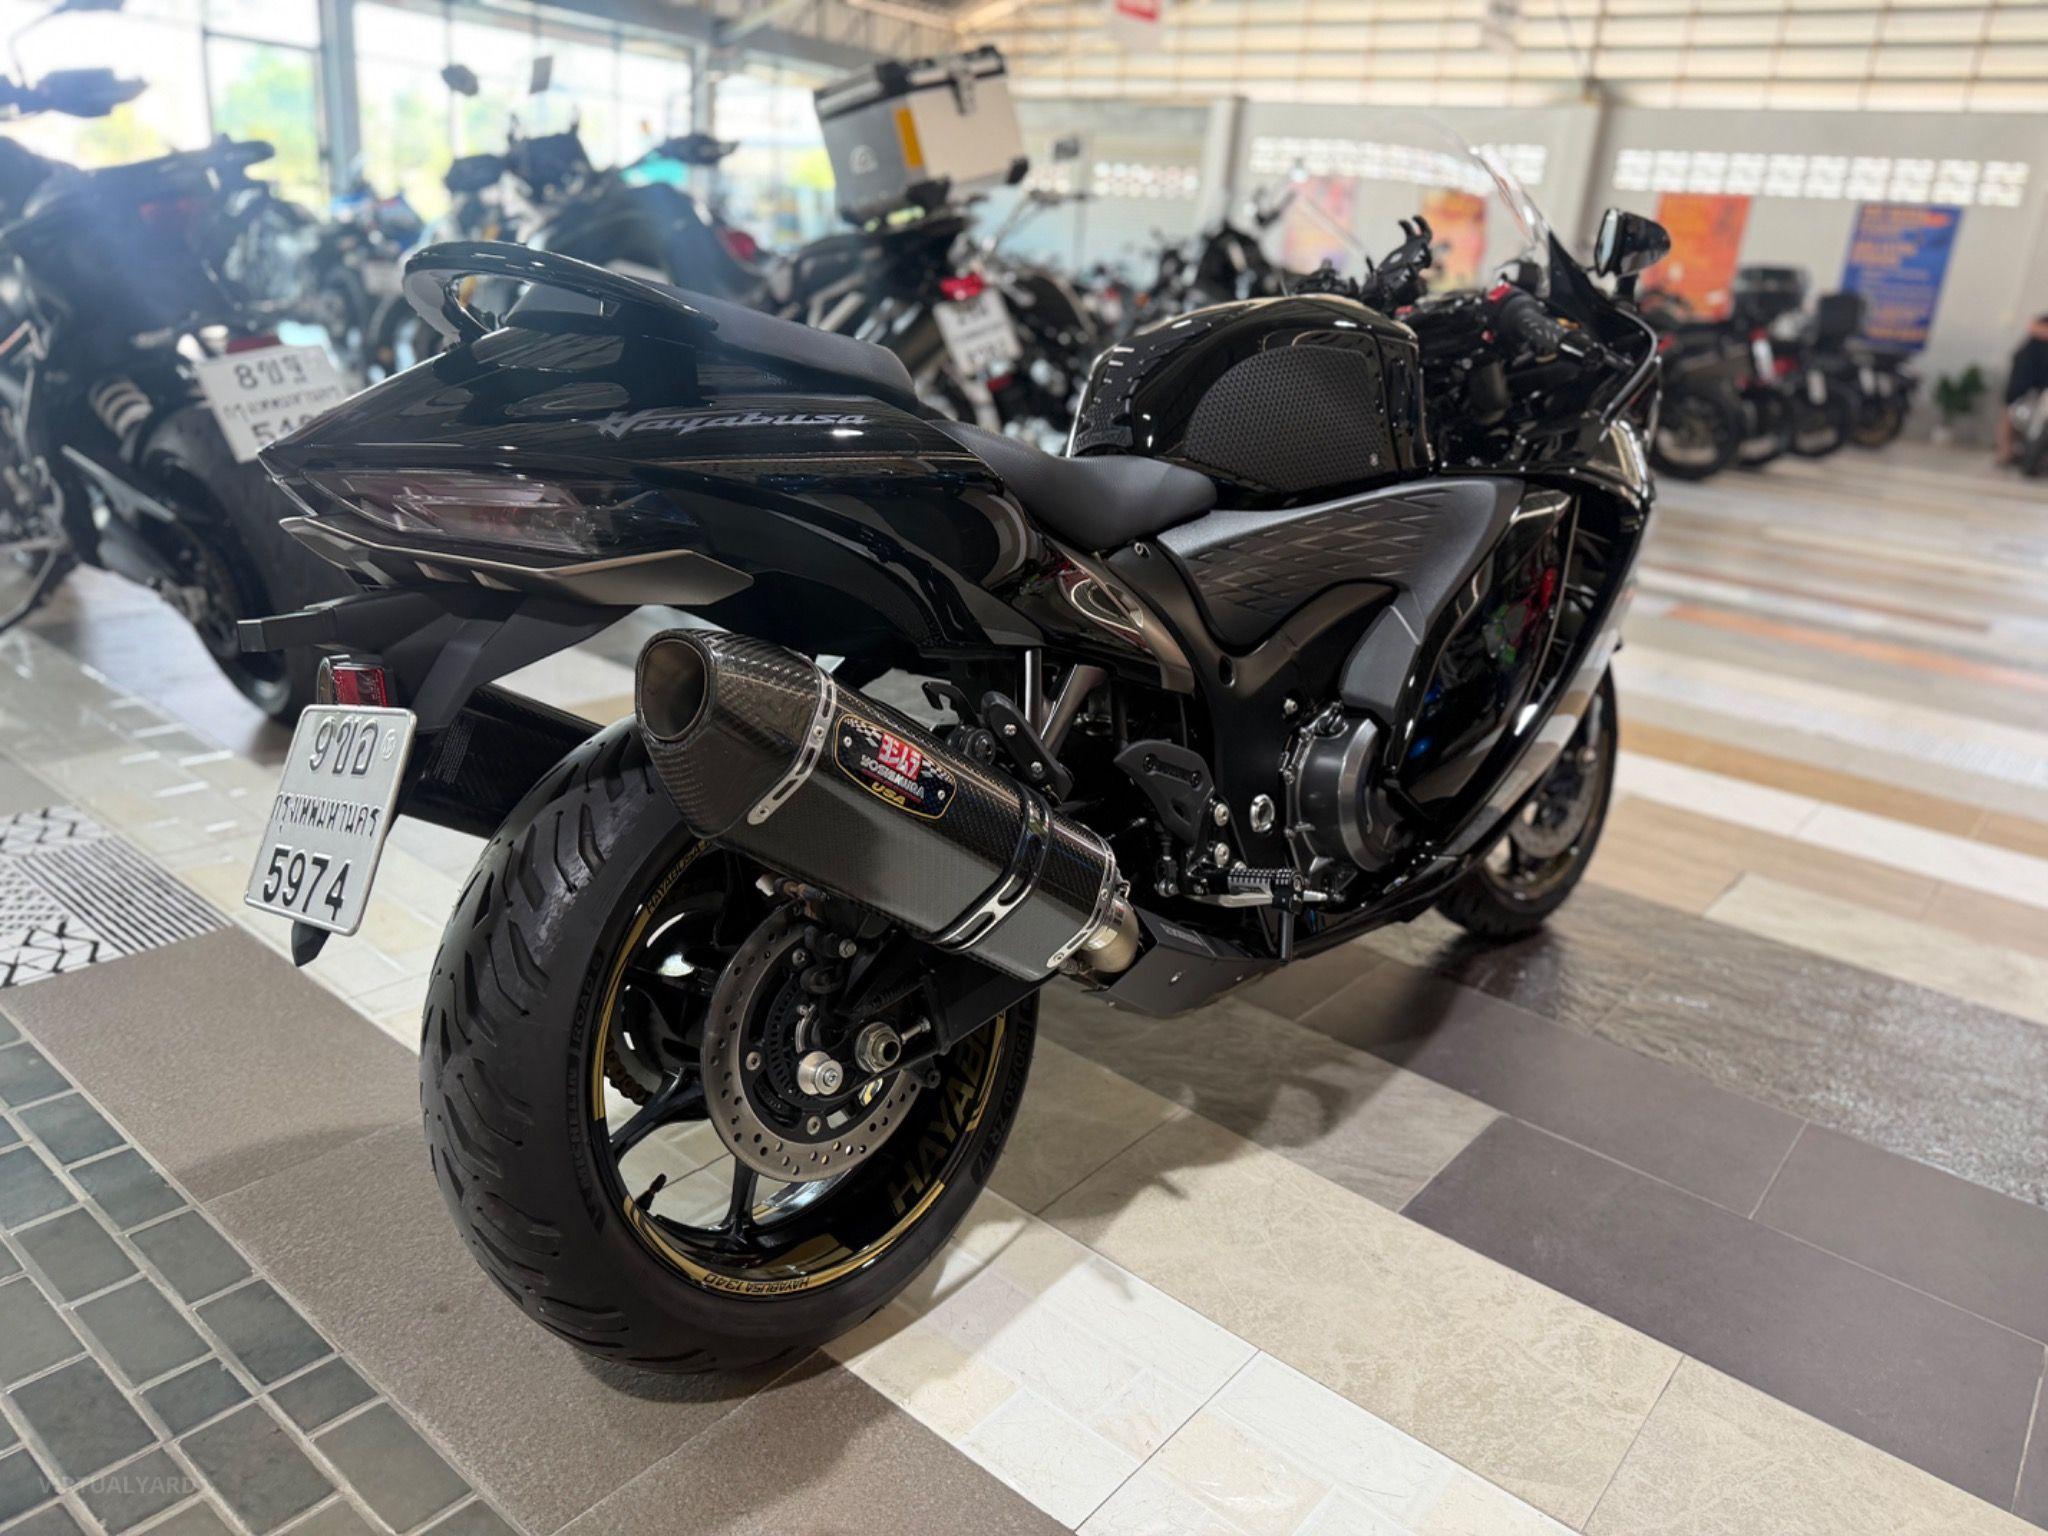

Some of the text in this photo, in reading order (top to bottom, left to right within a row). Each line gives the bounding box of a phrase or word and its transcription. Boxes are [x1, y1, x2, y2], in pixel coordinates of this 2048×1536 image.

[588, 410, 872, 440] Hayabusa
[309, 719, 379, 775] 9ขอ
[871, 781, 906, 806] USA
[274, 795, 382, 837] กรุงเทพมหานคร
[263, 846, 351, 921] 5974
